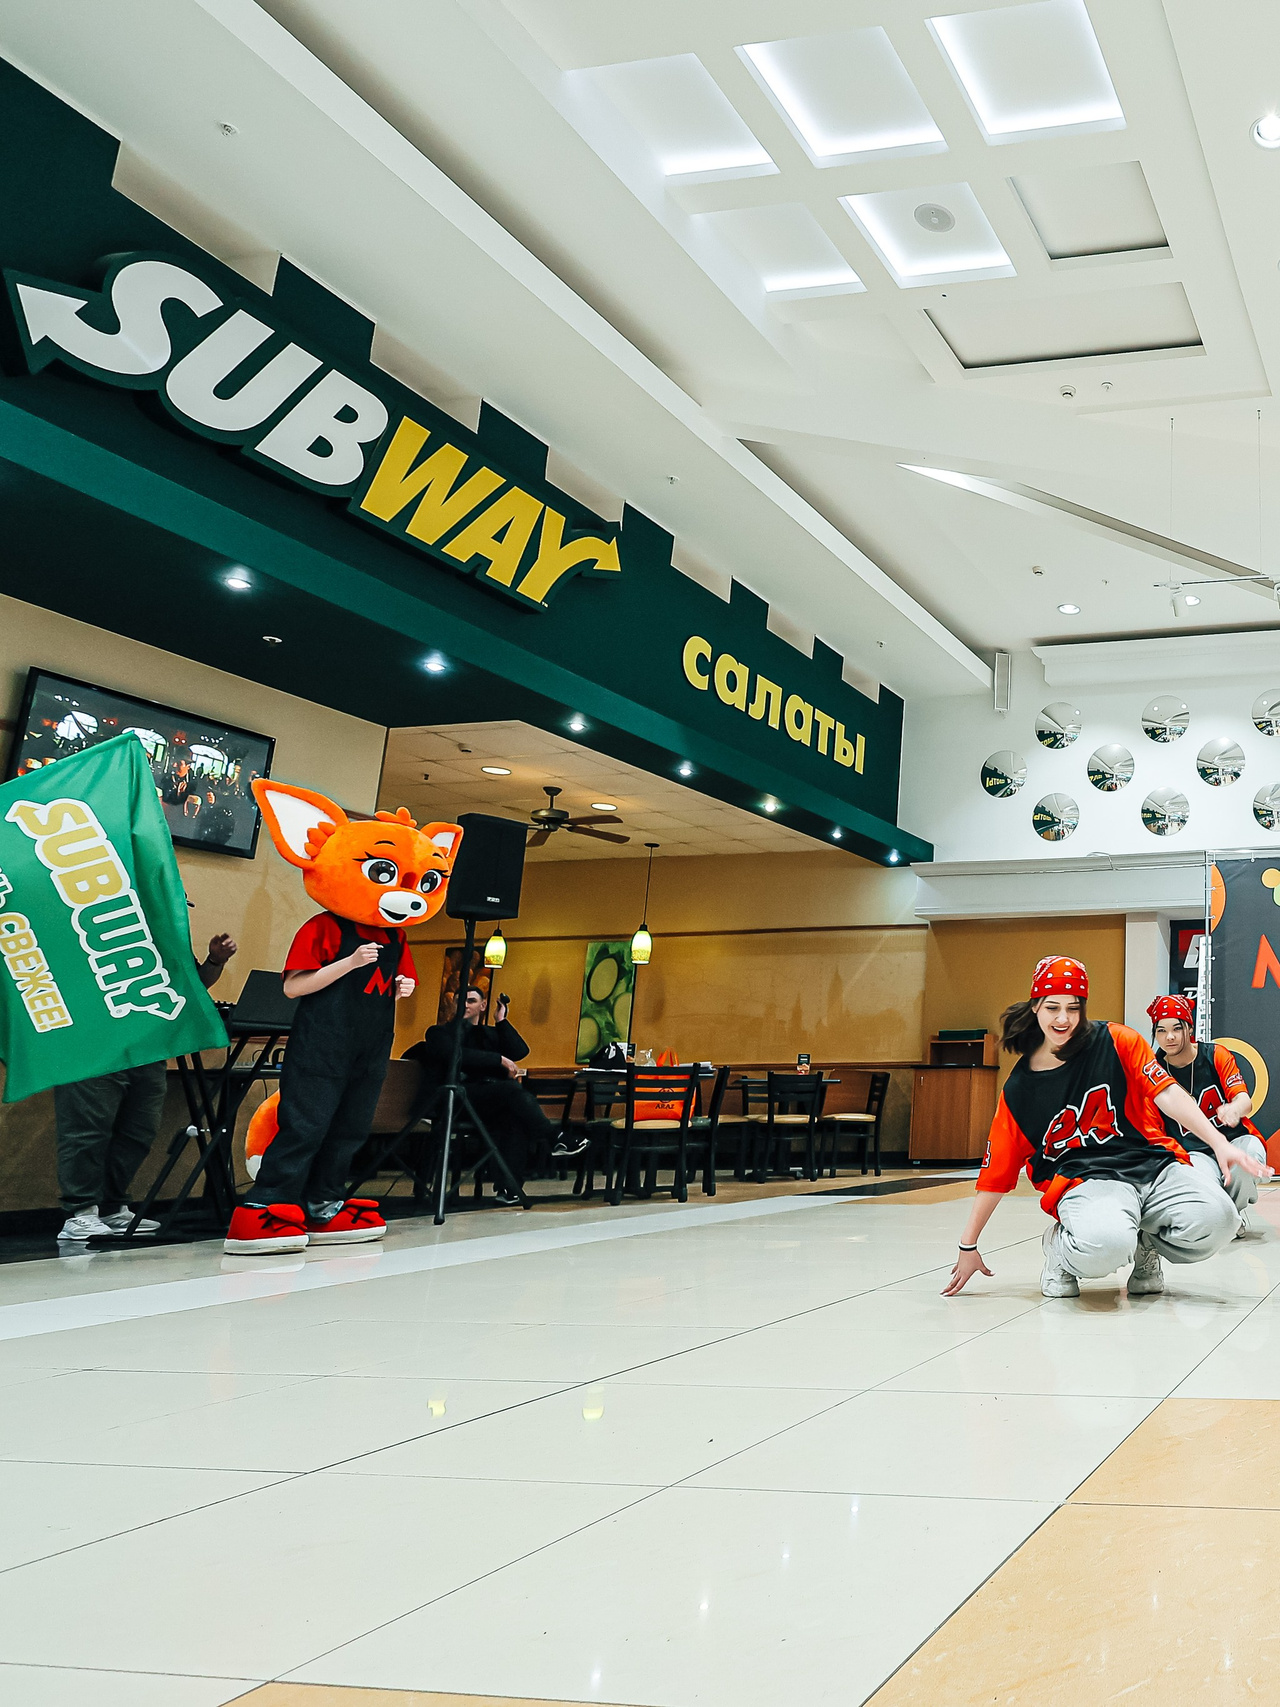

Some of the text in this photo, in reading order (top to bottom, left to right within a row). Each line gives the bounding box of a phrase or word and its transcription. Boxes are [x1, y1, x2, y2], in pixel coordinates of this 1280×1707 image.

[17, 260, 621, 603] SUBWAY
[683, 635, 866, 775] салаты
[0, 914, 70, 1031] СВЕЖЕЕ!
[8, 801, 183, 1018] SUBWAY
[1042, 1083, 1123, 1161] 24
